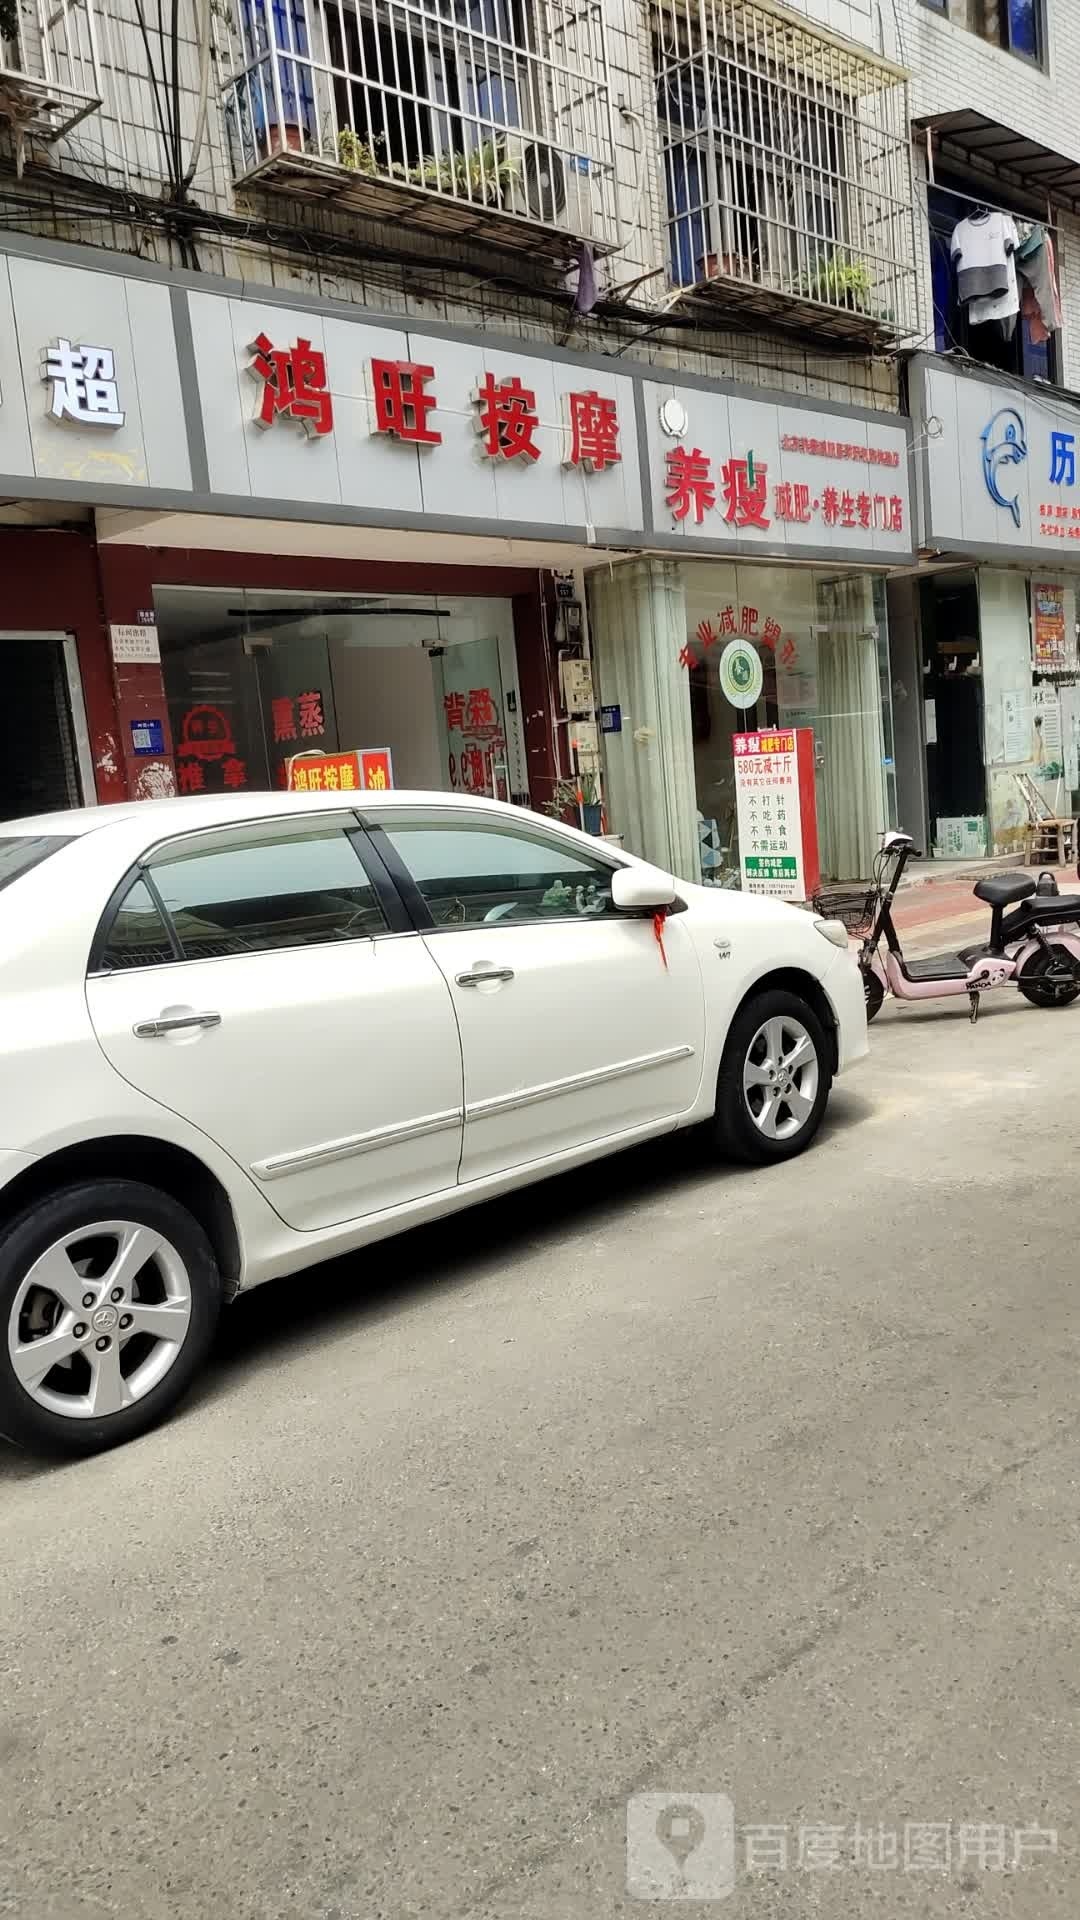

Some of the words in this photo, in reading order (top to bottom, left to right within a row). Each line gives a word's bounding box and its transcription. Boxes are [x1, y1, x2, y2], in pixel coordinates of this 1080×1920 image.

[43, 337, 126, 427] 超
[248, 332, 622, 471] 鸿旺按摩
[664, 445, 772, 529] 养瘦
[737, 755, 792, 774] 580元减十斤
[747, 794, 785, 806] 不打针
[750, 809, 786, 821] 不吃药
[750, 825, 787, 837] 不节食
[752, 840, 788, 851] 不需运动
